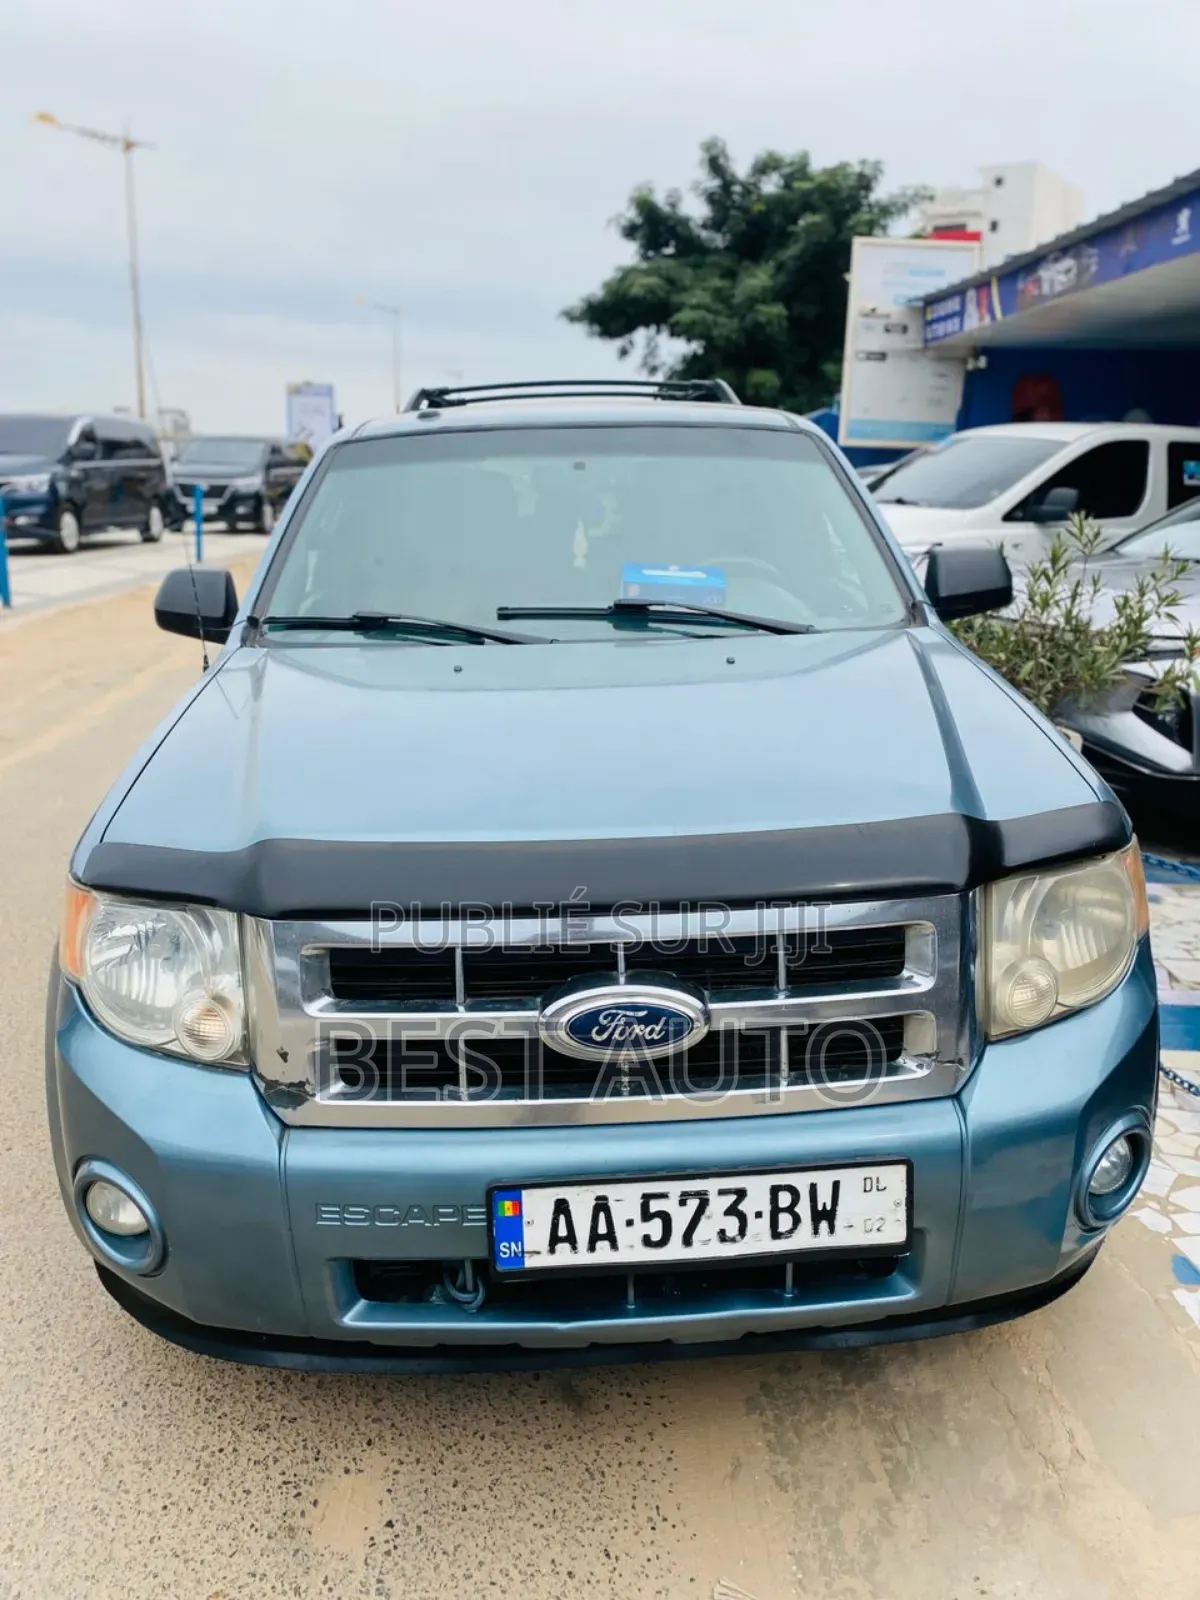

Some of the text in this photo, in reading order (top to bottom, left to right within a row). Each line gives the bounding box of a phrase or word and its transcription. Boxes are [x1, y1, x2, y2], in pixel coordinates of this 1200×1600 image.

[591, 1009, 668, 1042] Ford
[863, 1176, 887, 1193] DL
[315, 1203, 488, 1226] ESCAPE
[500, 1241, 522, 1258] SN
